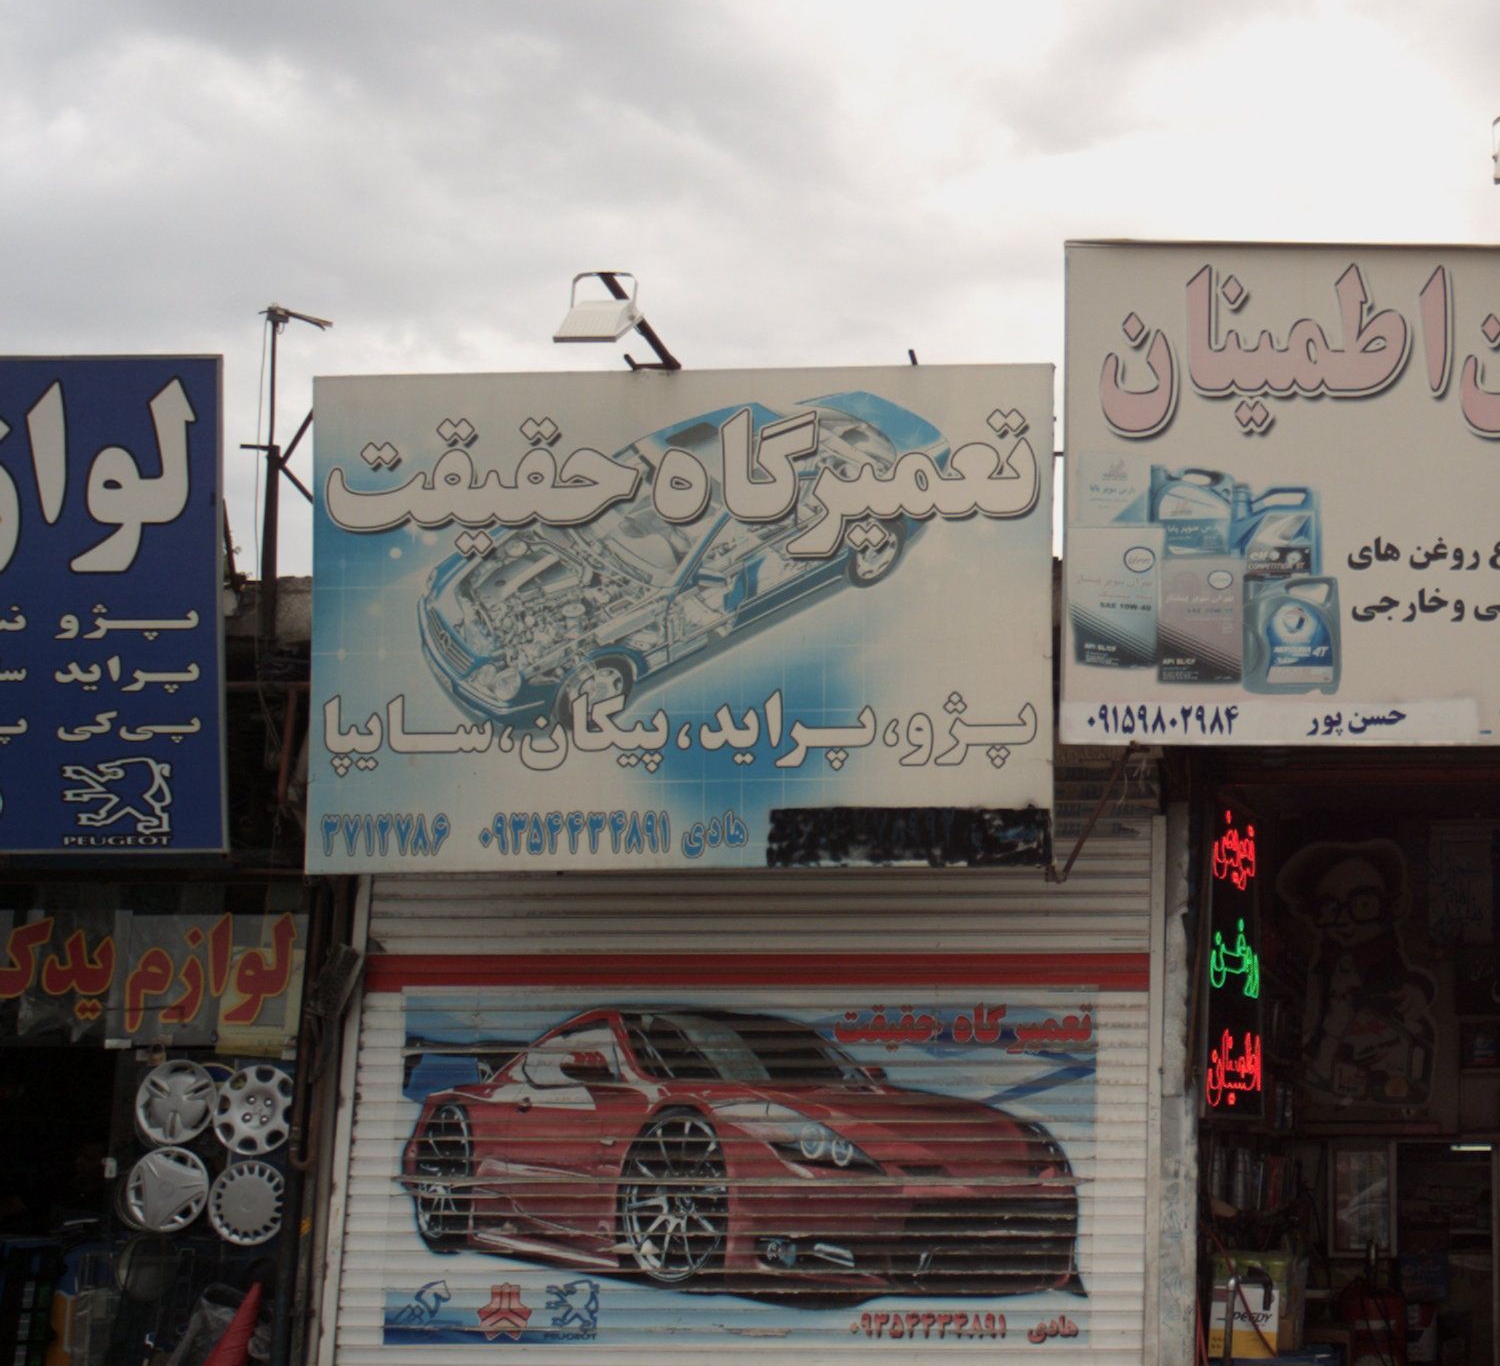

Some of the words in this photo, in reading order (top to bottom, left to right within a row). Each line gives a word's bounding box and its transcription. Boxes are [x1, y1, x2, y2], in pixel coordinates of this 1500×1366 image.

[1102, 263, 1454, 438] اطمینان
[325, 416, 642, 559] حقیقت
[652, 407, 1042, 560] تعمیرگاه
[1346, 536, 1400, 570] های
[1409, 536, 1480, 572] روغن
[55, 605, 200, 641] پژو
[54, 655, 200, 693] پراید
[322, 693, 494, 777] سایپا
[1087, 703, 1240, 736] ۰۹۱۵۹۸۰۲۹۸۴
[1306, 711, 1343, 739] پور
[1346, 708, 1407, 735] حسن
[63, 835, 171, 847] PEUGEOT
[321, 812, 451, 857] ۳۷۱۲۷۸۶
[479, 809, 671, 855] ۰۹۳۵۴۴۳۴۸۹۱
[681, 809, 749, 859] هادی
[121, 912, 297, 1033] لوازم
[834, 1003, 944, 1052] حقیقت
[952, 1003, 1093, 1054] تعمیرگاه
[1027, 1314, 1080, 1344] هادی
